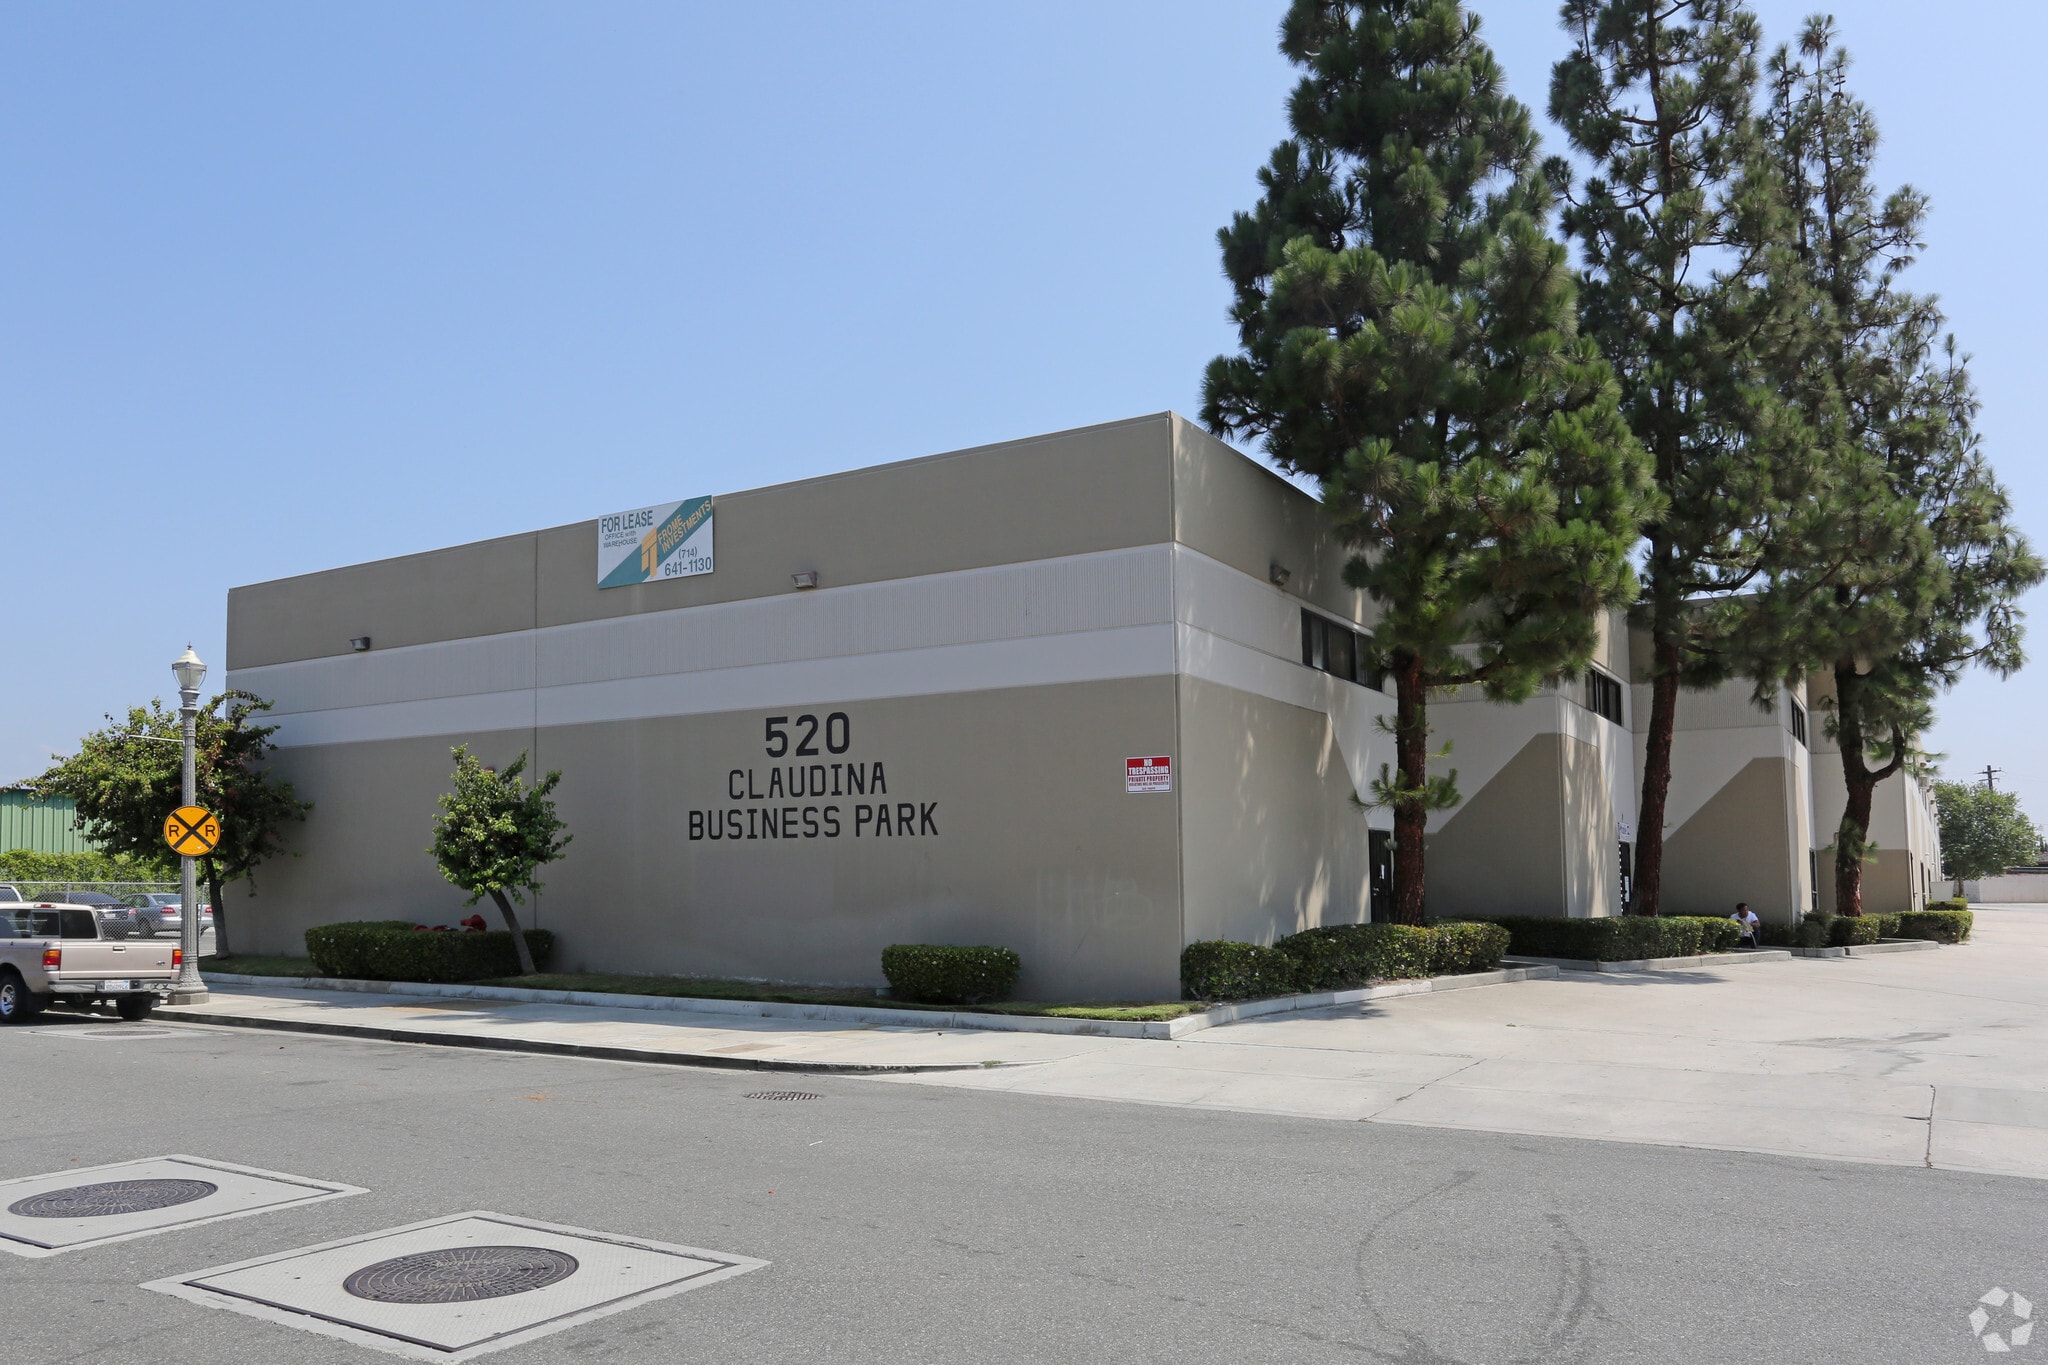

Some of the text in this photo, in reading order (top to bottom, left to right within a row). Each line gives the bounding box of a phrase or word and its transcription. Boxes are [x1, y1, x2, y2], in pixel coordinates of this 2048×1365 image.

[601, 510, 653, 534] FOR LEASE
[657, 514, 682, 543] FROME
[661, 500, 711, 554] INVESTMENTS
[603, 537, 638, 548] WAREHOUSE
[604, 531, 624, 541] OFFICE
[678, 546, 698, 560] (714)
[664, 556, 712, 576] 641-1130
[765, 712, 850, 758] 520
[1128, 766, 1168, 774] TRESPASSING
[1144, 758, 1152, 766] NO
[728, 761, 888, 800] CLAUDINA
[168, 824, 216, 838] R R
[688, 802, 939, 841] BUSINESS PARK
